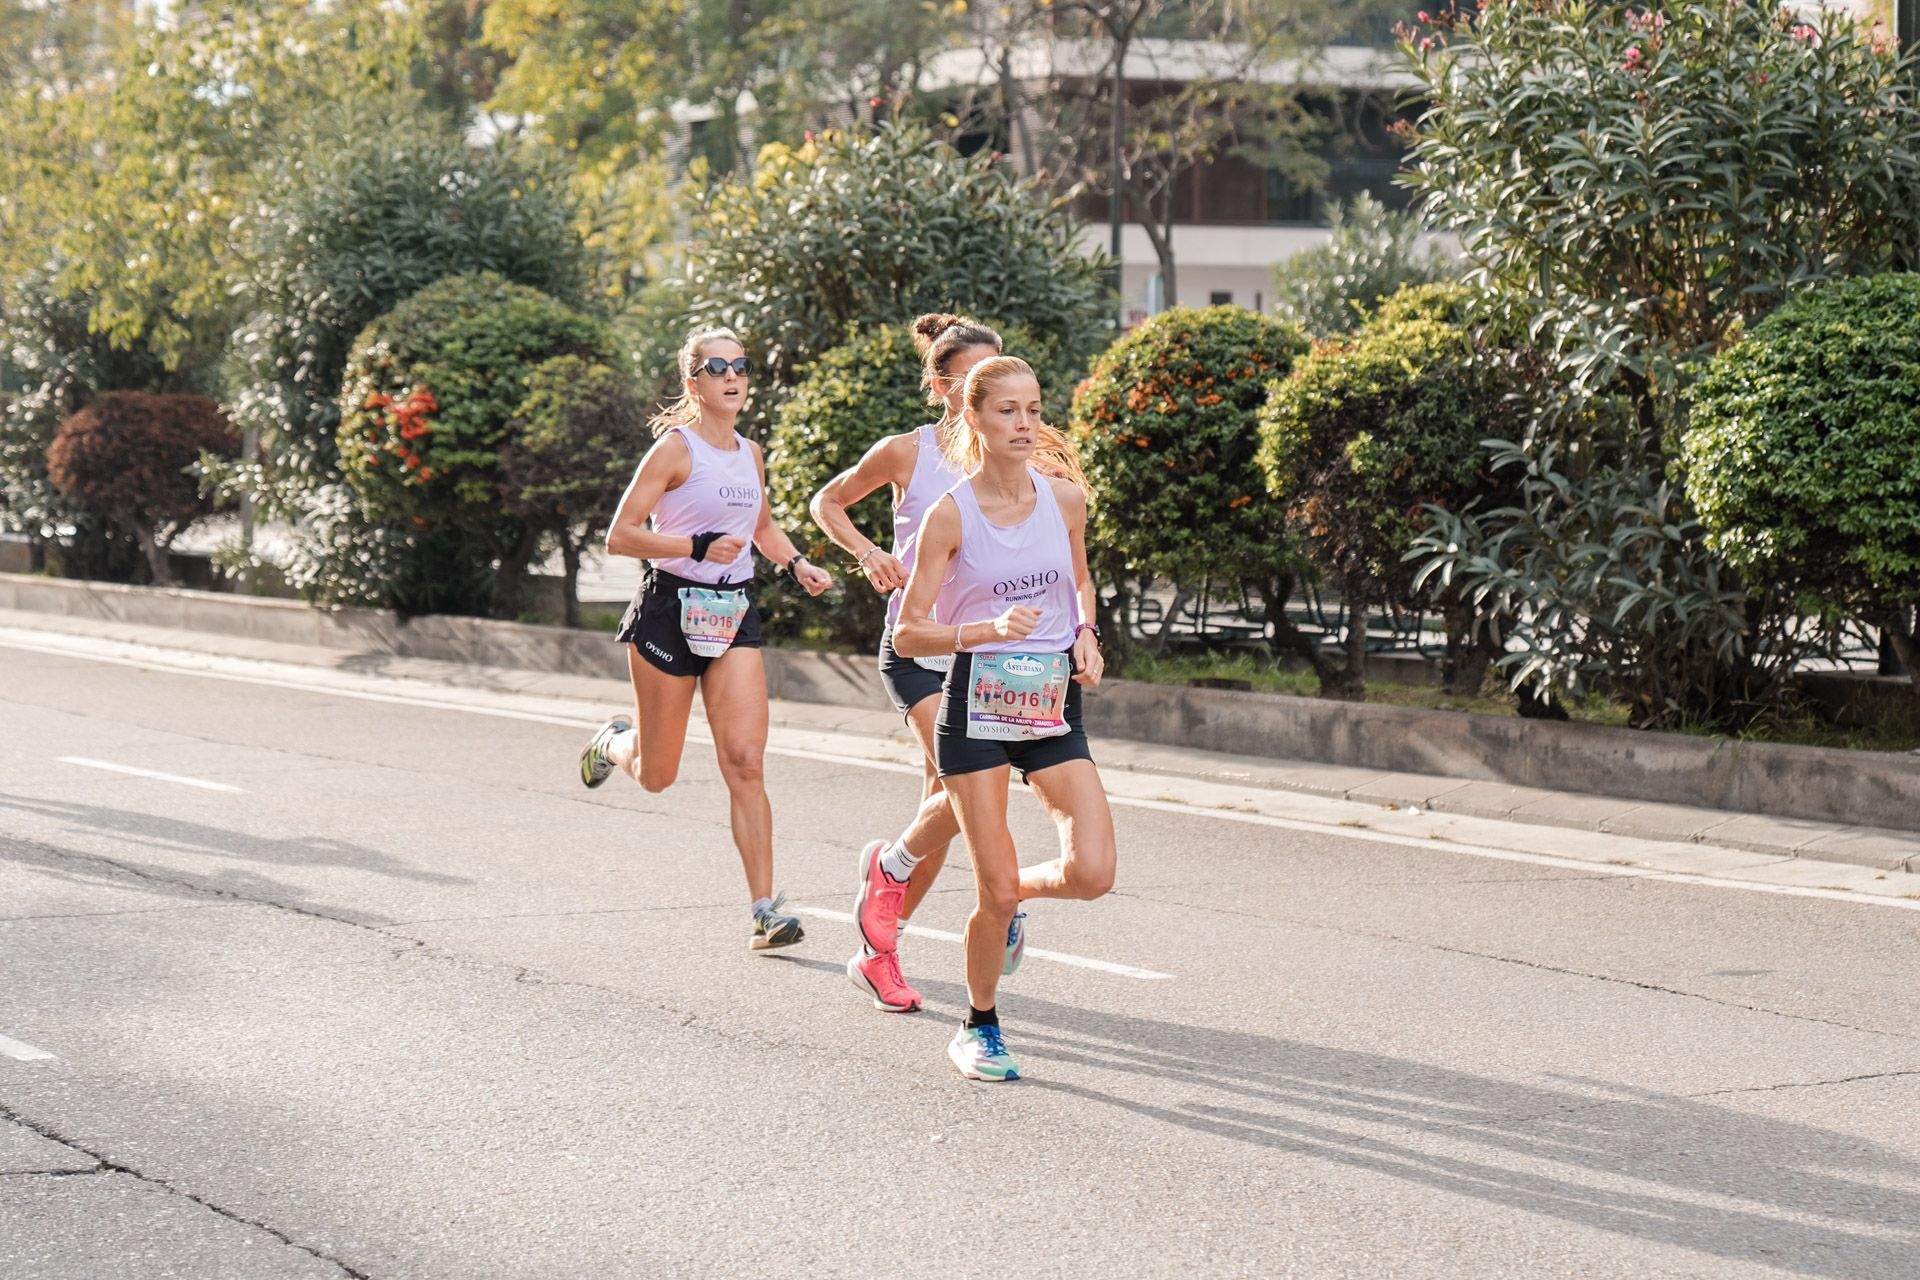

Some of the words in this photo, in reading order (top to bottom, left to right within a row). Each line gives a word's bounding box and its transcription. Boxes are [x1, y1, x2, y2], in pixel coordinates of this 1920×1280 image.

[719, 486, 759, 500] OYSHO
[993, 569, 1059, 596] OYSHO
[1005, 594, 1032, 602] RUNNING
[708, 614, 733, 628] 016
[645, 641, 673, 662] OYSHO
[1003, 690, 1039, 707] 016
[978, 725, 1010, 734] OYSHO
